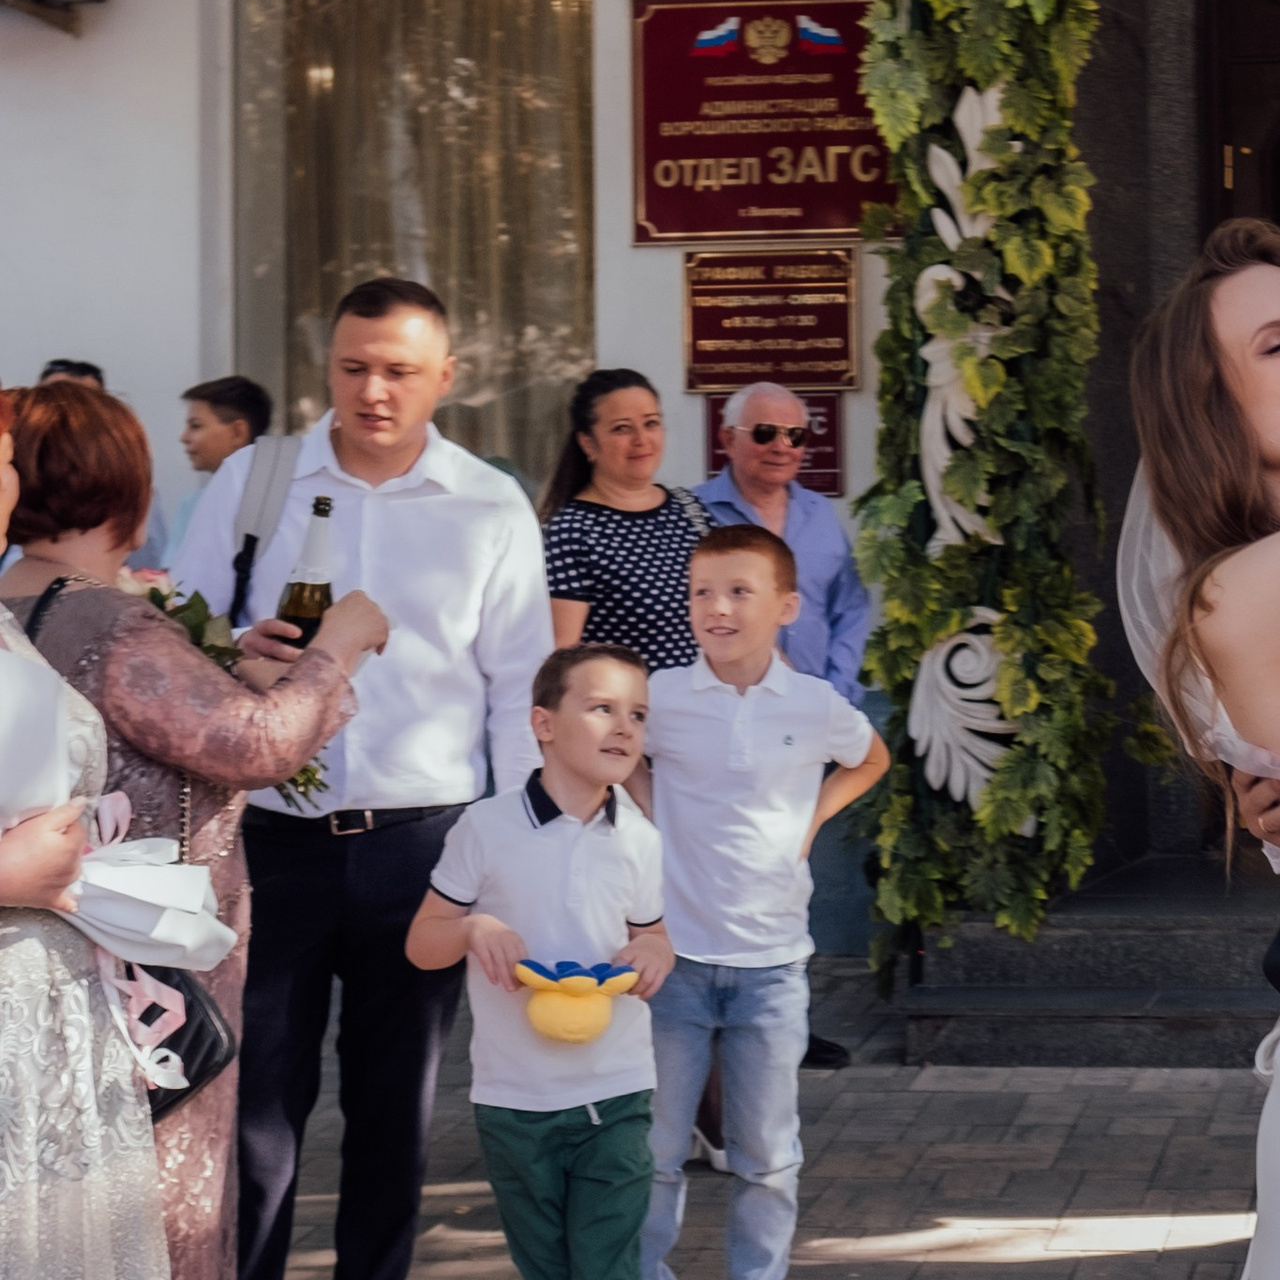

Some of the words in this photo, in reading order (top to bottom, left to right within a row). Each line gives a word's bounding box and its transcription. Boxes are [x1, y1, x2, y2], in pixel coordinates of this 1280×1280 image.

[700, 98, 839, 115] АДМИНИСТРАЦИЯ
[653, 157, 760, 191] ОТДЕЛ
[767, 145, 880, 184] ЗАГС
